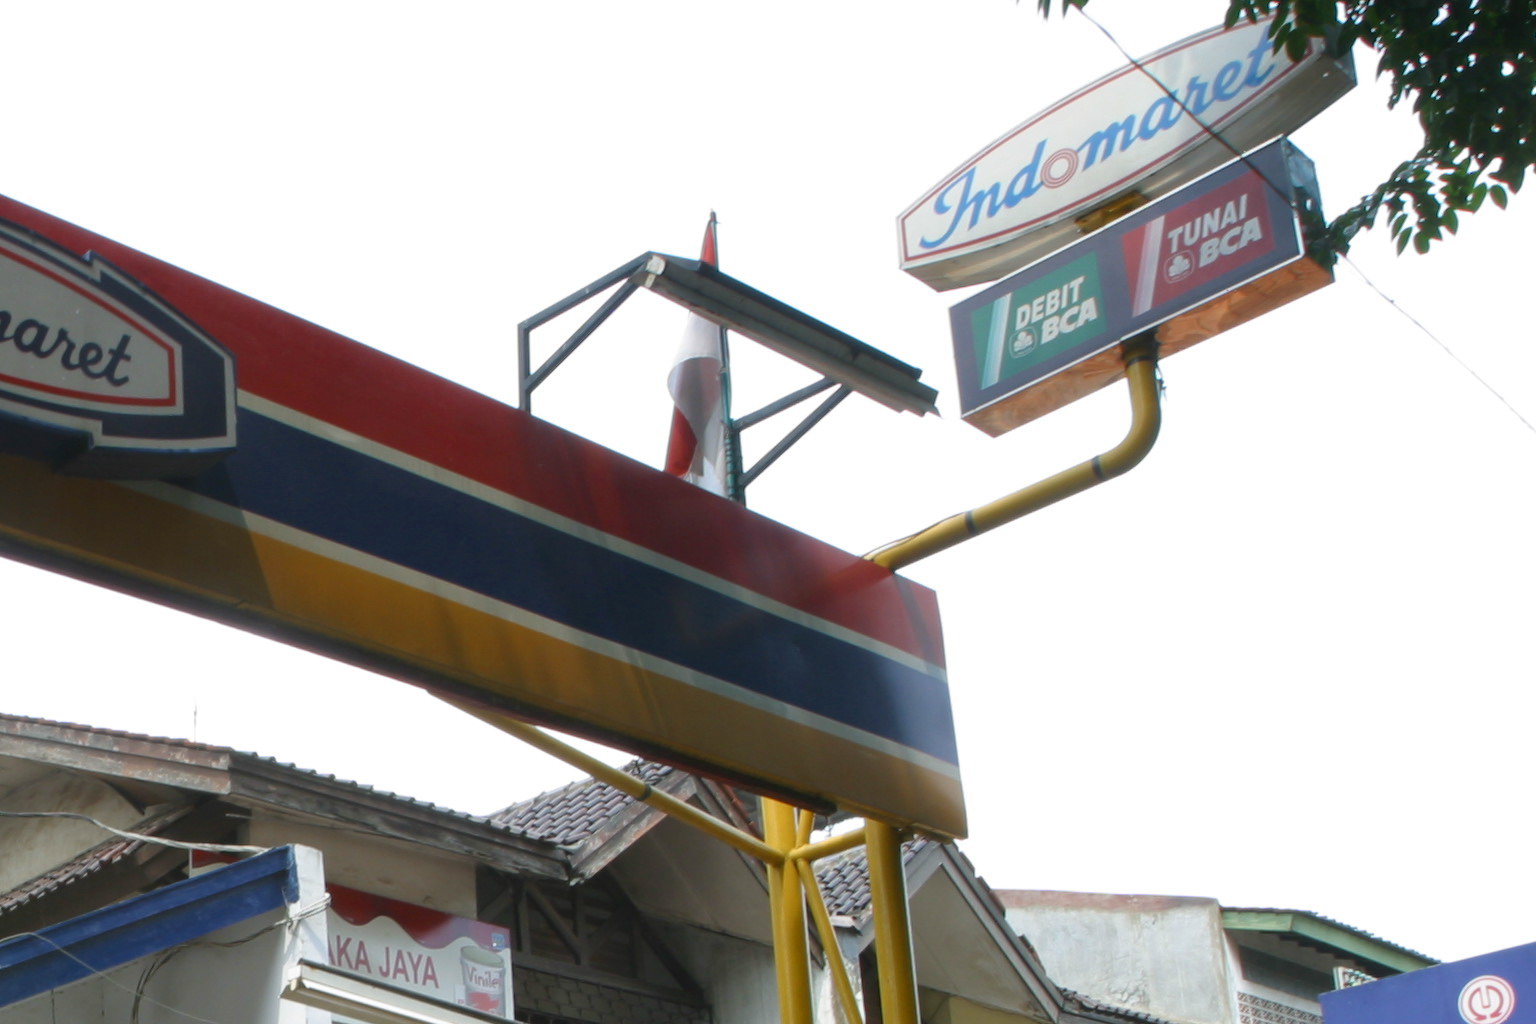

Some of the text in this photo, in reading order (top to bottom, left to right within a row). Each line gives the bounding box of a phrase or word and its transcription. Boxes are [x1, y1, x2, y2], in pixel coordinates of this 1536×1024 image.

[919, 24, 1277, 250] Indomaret
[1168, 193, 1248, 254] TUNAI
[1198, 216, 1263, 268] BCA
[1015, 275, 1085, 331] DEBIT
[1040, 297, 1098, 345] BCA
[379, 946, 440, 990] JAYA
